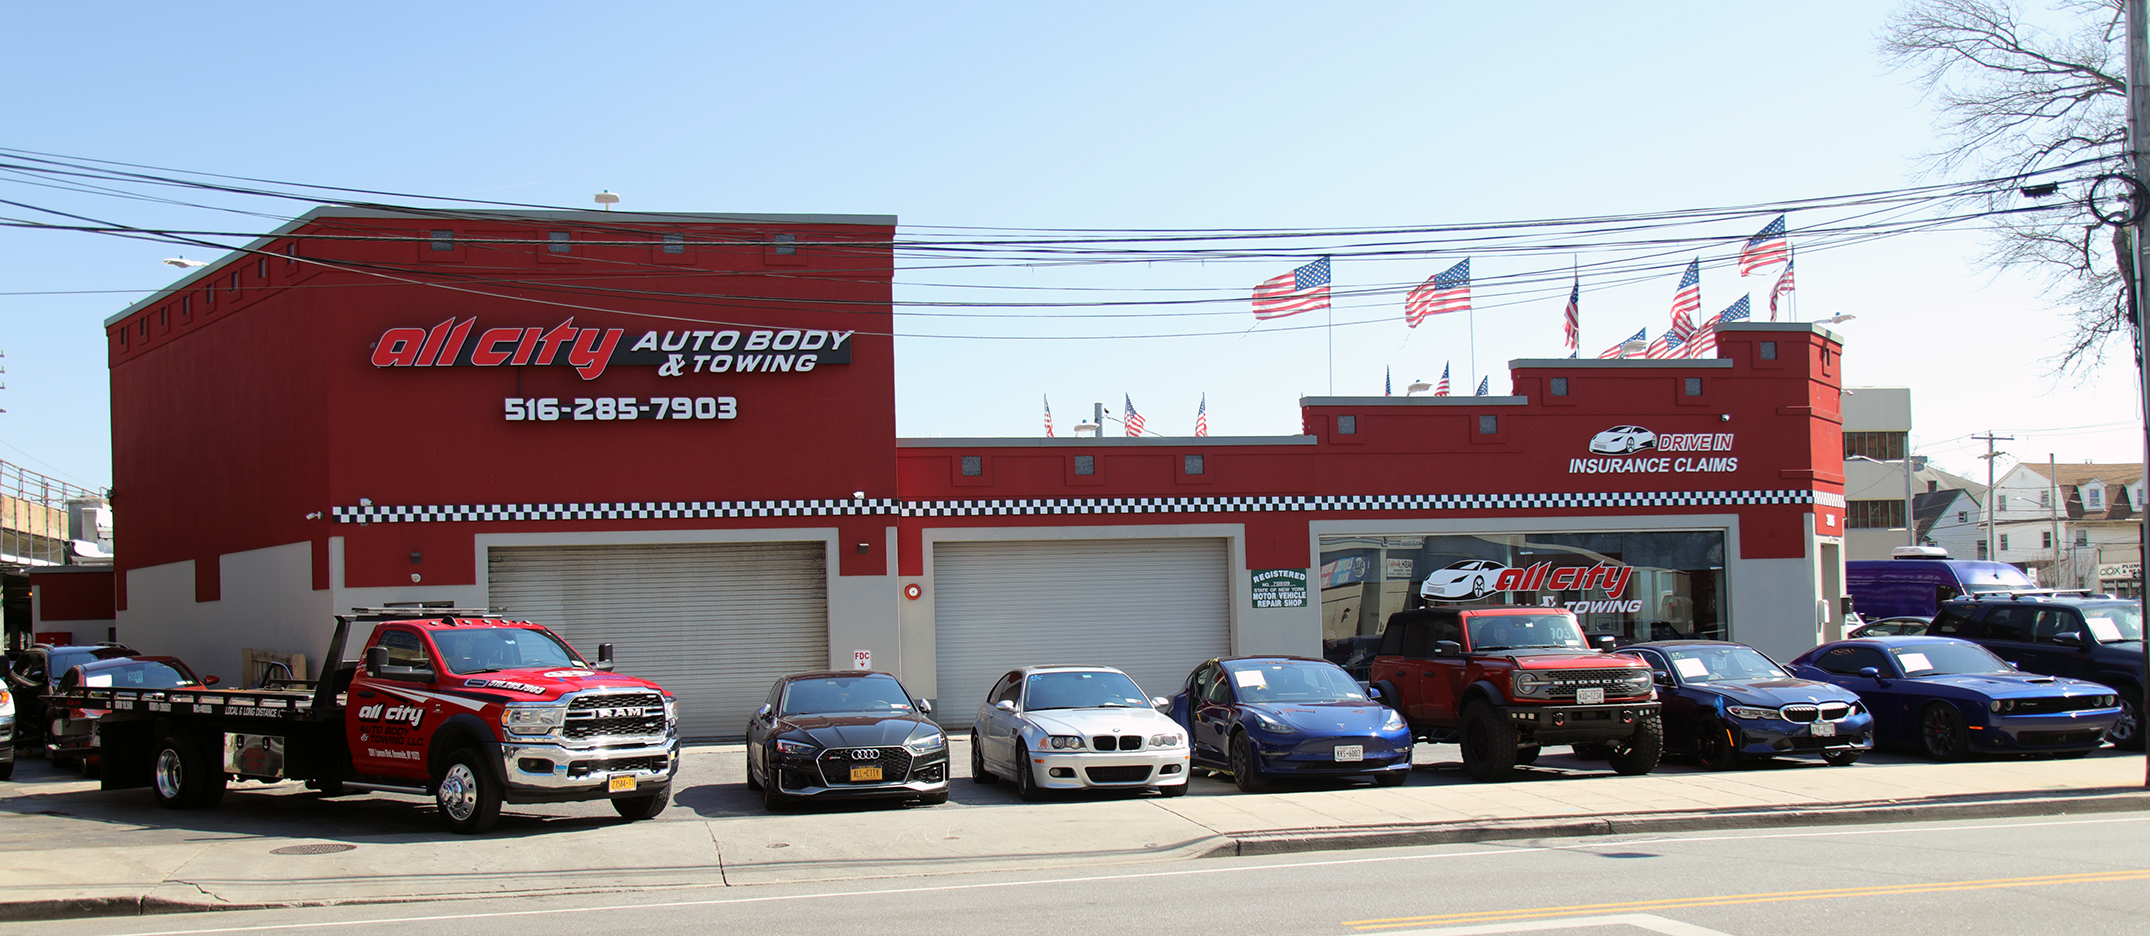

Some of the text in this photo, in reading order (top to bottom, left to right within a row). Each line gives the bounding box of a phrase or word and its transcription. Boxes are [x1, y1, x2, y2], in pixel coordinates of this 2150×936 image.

[631, 329, 855, 351] AUTO BODY
[658, 354, 818, 377] & TOWING
[505, 397, 737, 420] 516-285-7903
[1658, 434, 1734, 451] DRIVE IN
[1569, 457, 1738, 474] INSURANCE CLAIMS
[1253, 570, 1306, 583] REGISTERED
[2099, 566, 2121, 576] COX
[1253, 591, 1306, 600] MOTOR VEHICLE
[1284, 599, 1302, 607] SHOP
[1563, 600, 1643, 614] TOWING
[855, 652, 870, 660] FDC
[225, 706, 239, 715] LOCAL
[243, 707, 255, 716] LONG
[255, 708, 277, 717] DISTANCE
[599, 707, 641, 718] RAM
[359, 725, 411, 736] AUTO BODY
[360, 733, 369, 742] &
[370, 735, 405, 745] TOWING
